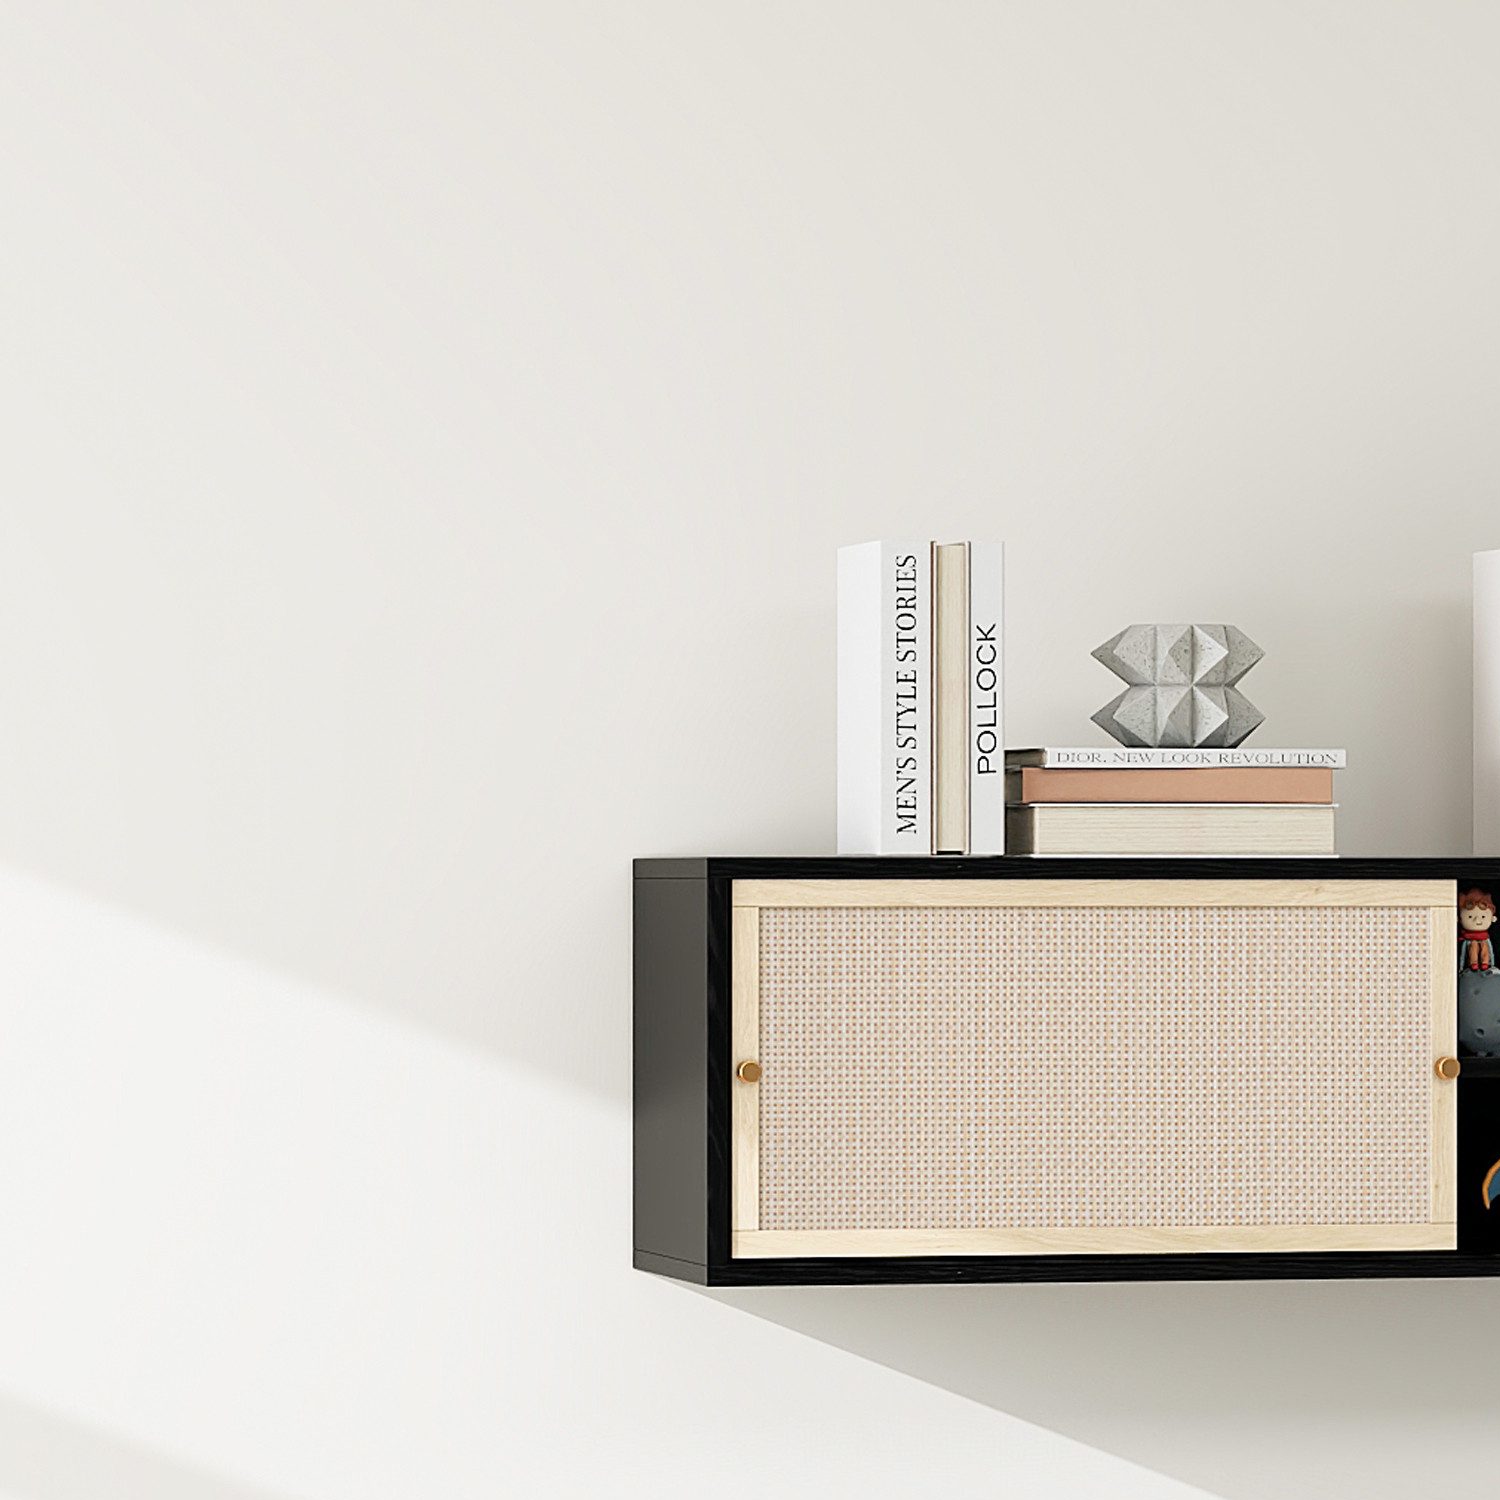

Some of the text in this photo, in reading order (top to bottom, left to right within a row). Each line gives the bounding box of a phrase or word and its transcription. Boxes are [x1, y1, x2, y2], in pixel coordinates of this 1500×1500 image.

[896, 555, 917, 834] MEN'S STYLE STORIES
[976, 623, 997, 774] POLLOCK
[1112, 752, 1155, 764] NEW
[1161, 752, 1211, 764] LOOK
[1219, 752, 1338, 764] REVOLUTION
